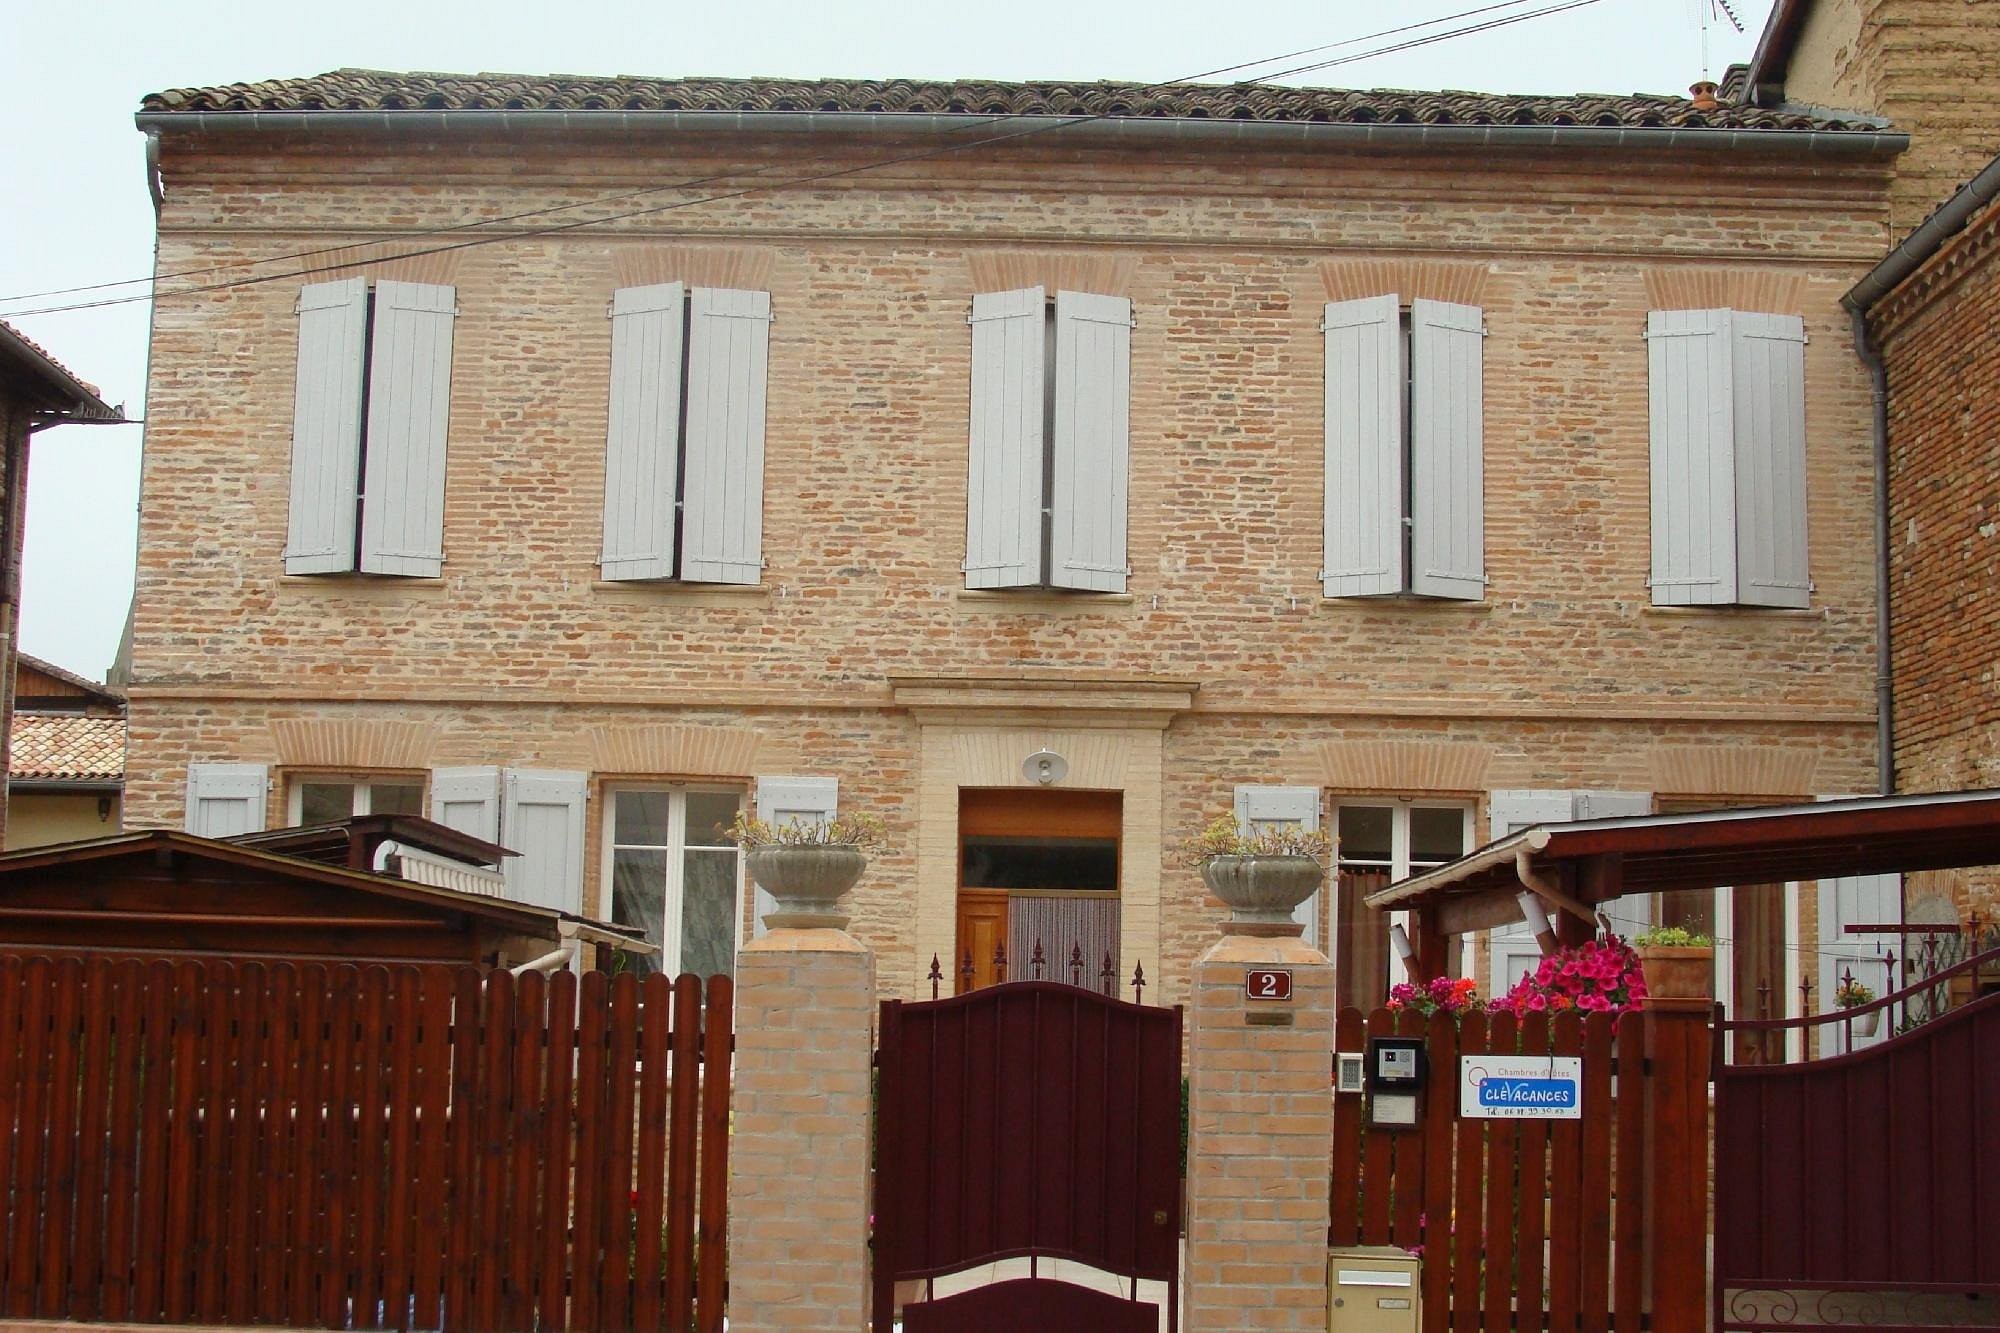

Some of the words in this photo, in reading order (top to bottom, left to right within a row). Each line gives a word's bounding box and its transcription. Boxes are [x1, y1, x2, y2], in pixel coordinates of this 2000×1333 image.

[1261, 974, 1276, 996] 2
[1498, 1068, 1538, 1077] Chambres
[1485, 1081, 1569, 1103] CLÉVACANCES
